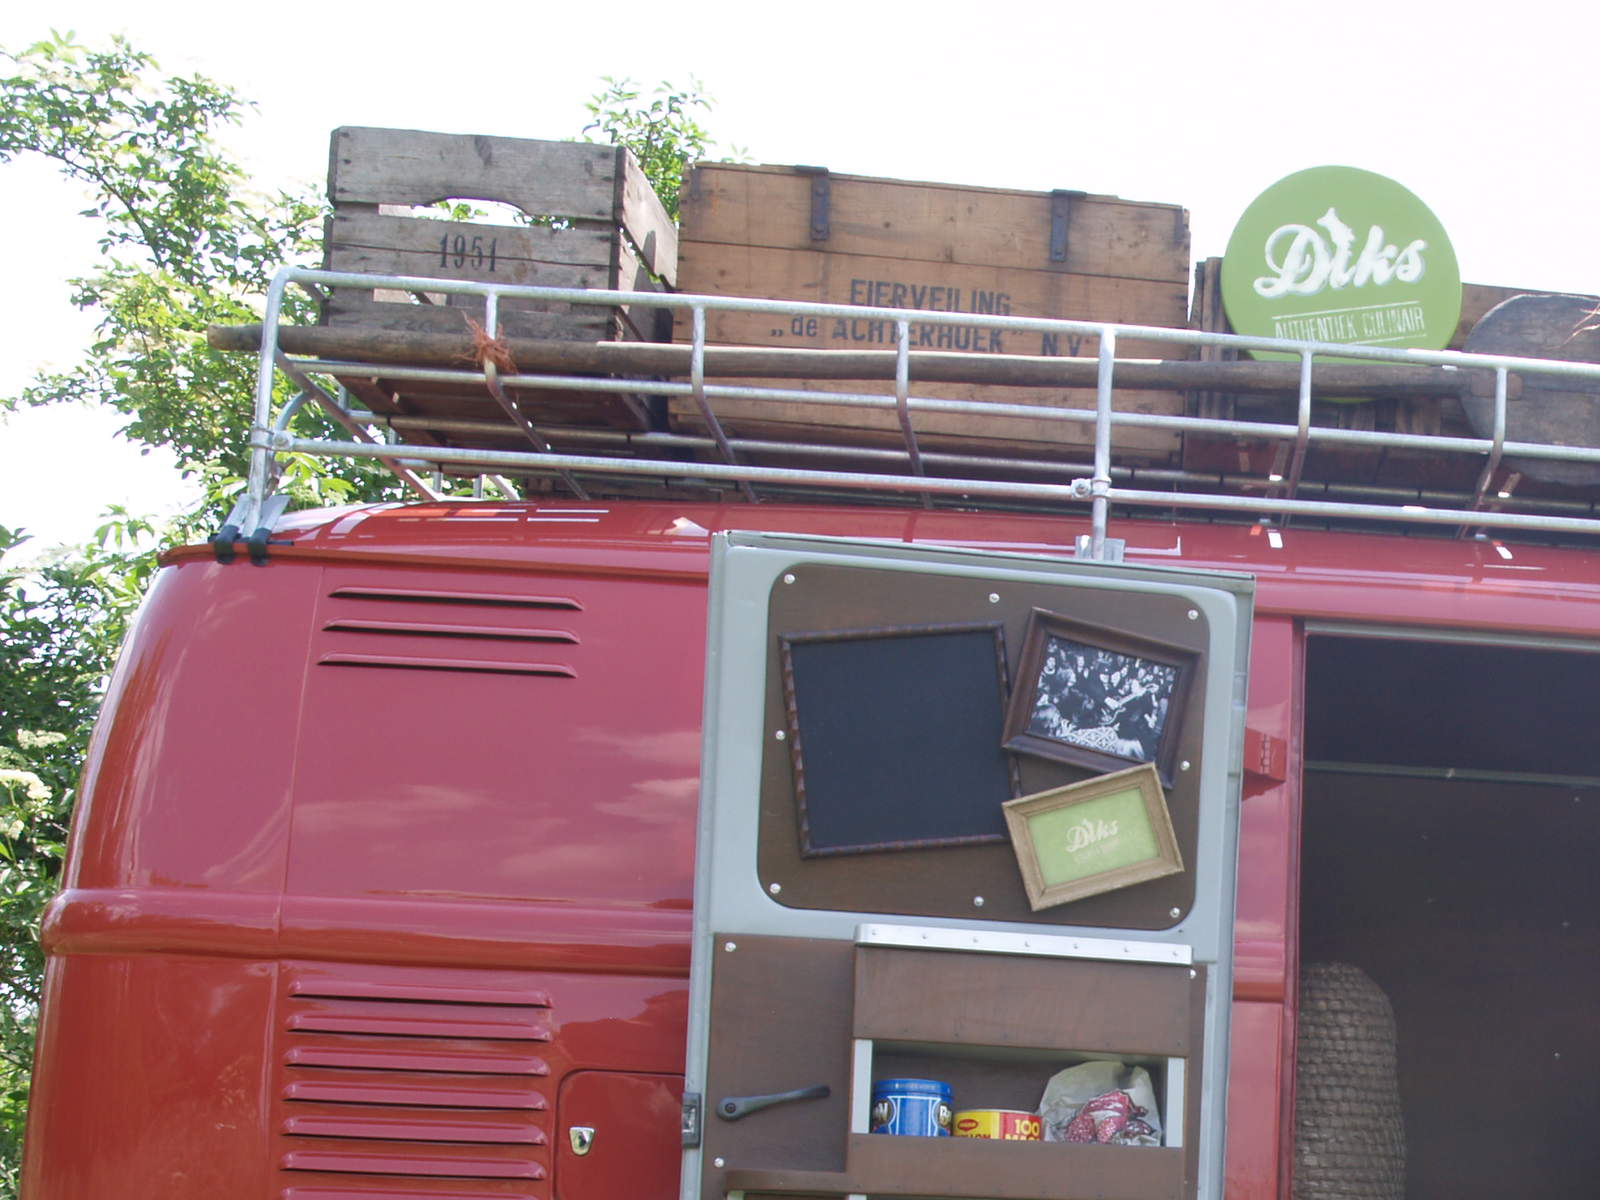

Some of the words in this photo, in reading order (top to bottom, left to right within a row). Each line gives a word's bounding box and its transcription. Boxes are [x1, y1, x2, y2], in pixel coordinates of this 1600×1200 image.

[439, 232, 498, 272] 1951
[1253, 207, 1428, 298] Diks
[850, 278, 1012, 316] EIERVEILING
[1274, 314, 1358, 343] AUTHENTIEK
[1362, 306, 1426, 338] CULINAIR
[1013, 1119, 1041, 1137] 100
